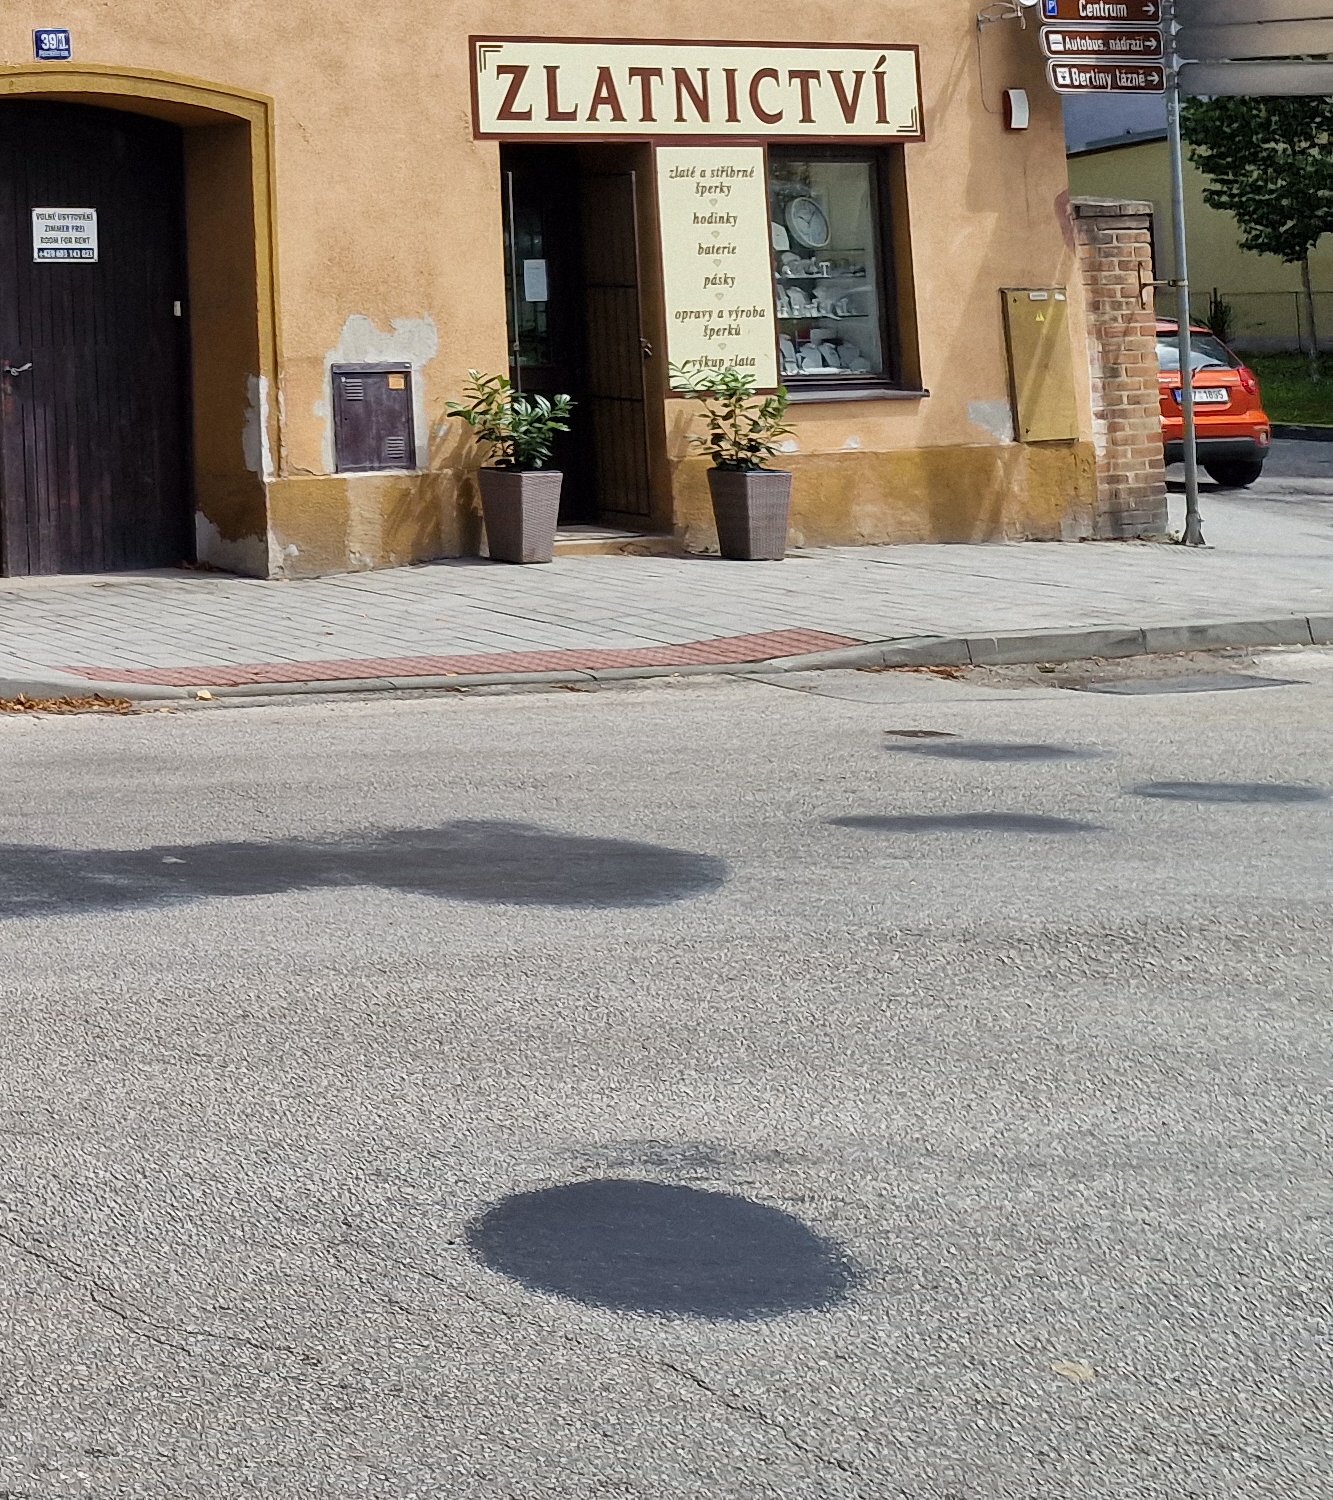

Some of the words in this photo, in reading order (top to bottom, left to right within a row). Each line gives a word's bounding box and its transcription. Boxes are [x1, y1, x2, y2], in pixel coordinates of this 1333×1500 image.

[1065, 36, 1107, 51] Autobus.
[1070, 67, 1112, 90] Bertiny
[496, 54, 891, 125] ZLATNICTVÍ
[668, 165, 696, 180] zlaté
[699, 169, 707, 178] a
[709, 165, 755, 179] stříbrné
[694, 181, 732, 198] šperky
[692, 211, 738, 228] hodinky
[697, 242, 737, 256] baterie
[703, 273, 736, 290] pásky
[674, 309, 714, 323] opravy
[717, 310, 724, 319] a
[728, 306, 766, 322] výroba
[703, 323, 741, 340] šperků
[693, 355, 724, 371] výkup
[729, 354, 756, 368] zlata
